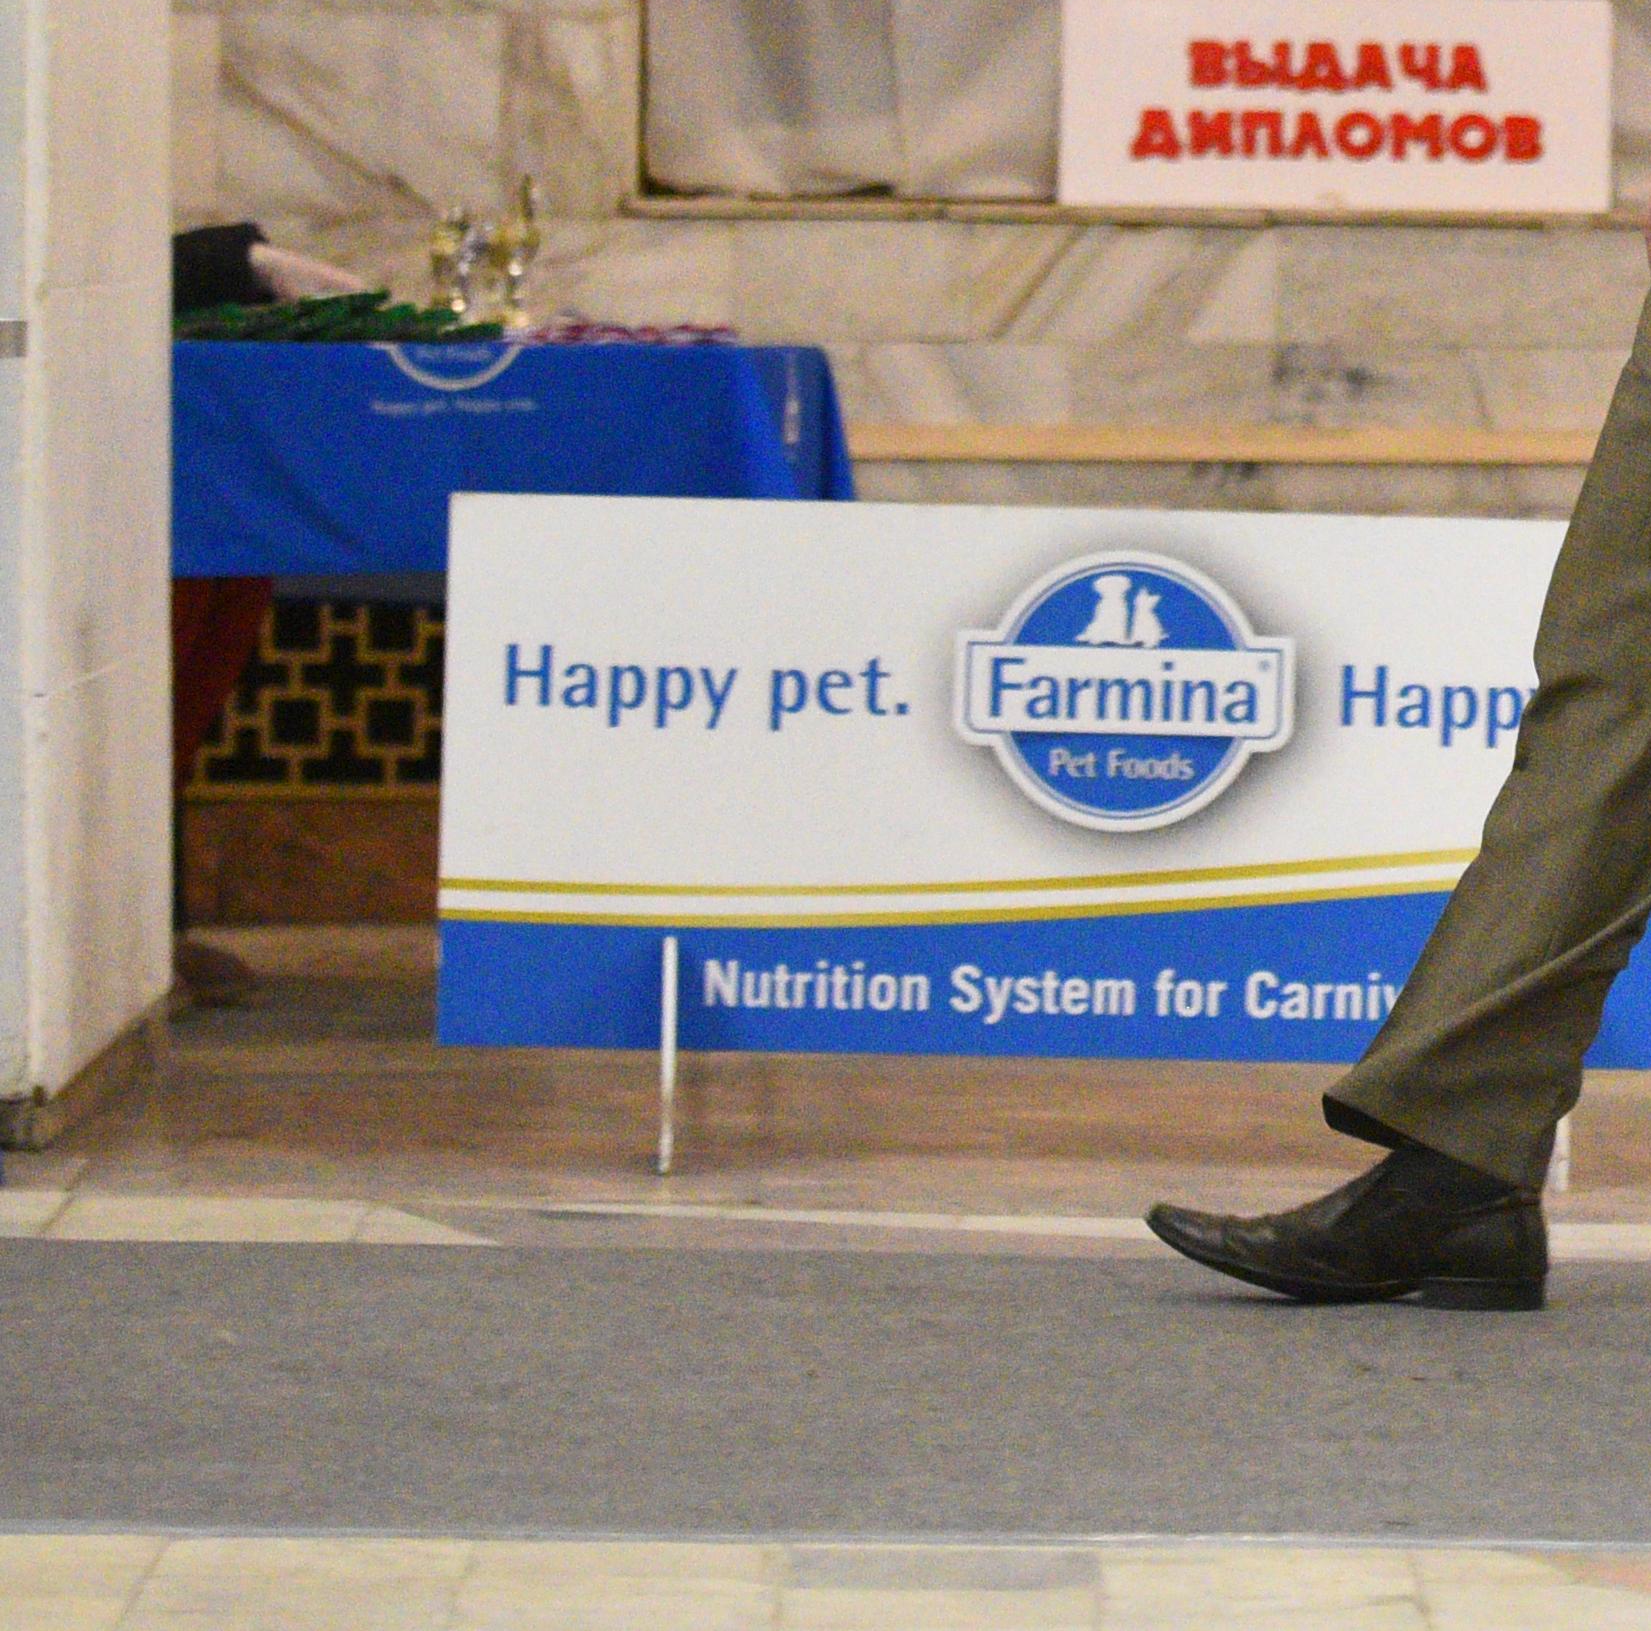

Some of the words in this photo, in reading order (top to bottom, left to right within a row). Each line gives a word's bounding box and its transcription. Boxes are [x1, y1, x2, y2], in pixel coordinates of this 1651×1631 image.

[1187, 39, 1489, 94] ВЫДАЧА
[1127, 107, 1544, 165] ДИПЛОМОВ
[504, 643, 738, 730] Happy
[770, 656, 911, 732] pet.
[989, 656, 1258, 725] Farmina
[1340, 664, 1537, 749] Happ
[1049, 748, 1097, 779] Pet
[1106, 749, 1195, 781] Foods
[703, 958, 931, 1011] Nutrition
[948, 964, 1136, 1025] System
[1153, 968, 1228, 1018] for
[1245, 970, 1407, 1021] Carniv
